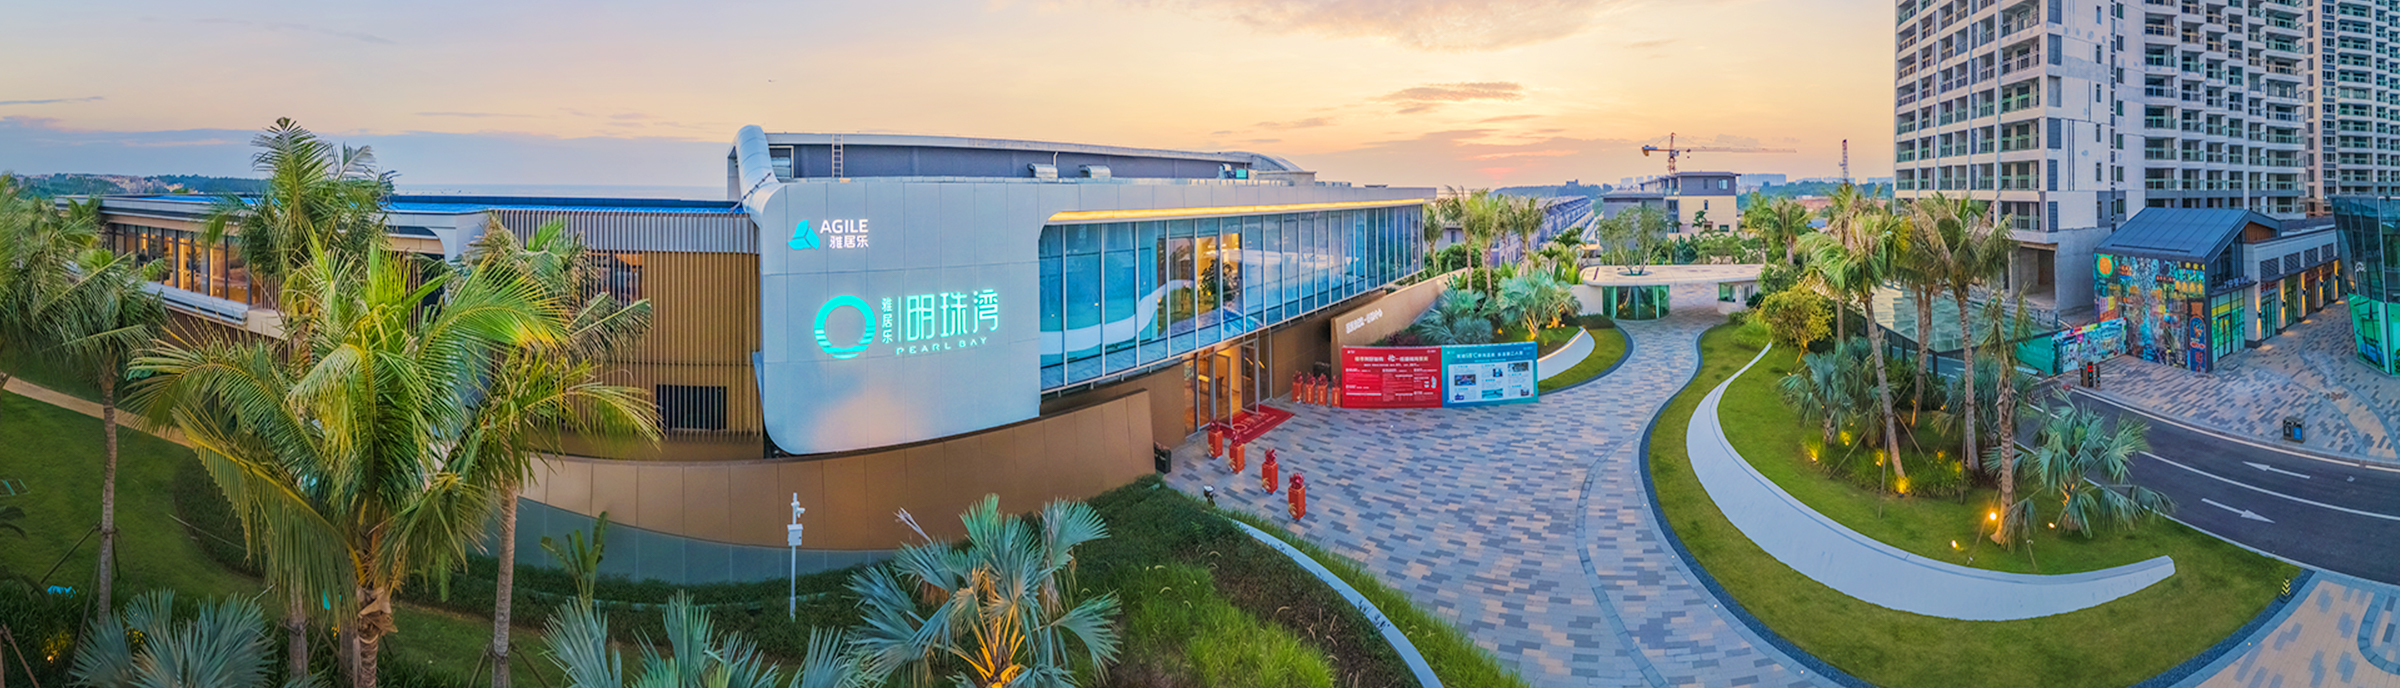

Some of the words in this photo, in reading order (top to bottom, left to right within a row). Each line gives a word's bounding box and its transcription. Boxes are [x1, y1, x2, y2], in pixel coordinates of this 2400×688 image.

[820, 219, 869, 234] AGILE
[829, 235, 869, 249] 雅居乐
[906, 288, 998, 341] 明珠湾
[895, 342, 951, 355] PEARL
[958, 337, 987, 348] BAY
